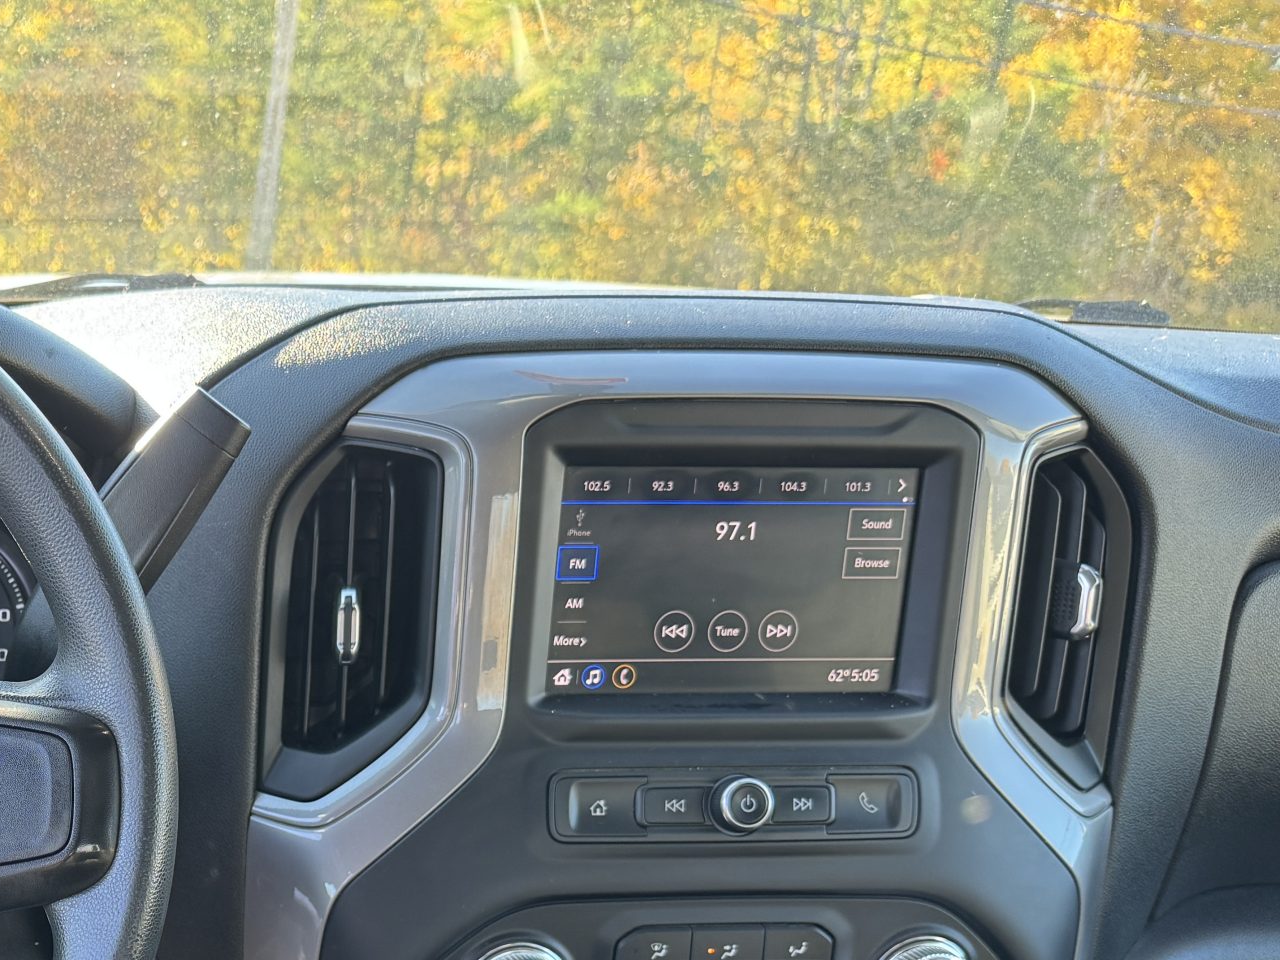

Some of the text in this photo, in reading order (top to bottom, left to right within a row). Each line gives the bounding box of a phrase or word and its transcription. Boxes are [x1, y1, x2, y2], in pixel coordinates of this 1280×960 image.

[583, 480, 611, 492] 102.5
[652, 480, 674, 492] 92.3
[717, 480, 740, 492] 96.3
[780, 481, 807, 493] 104.3
[844, 481, 872, 493] 101.3
[861, 518, 892, 530] Sound
[567, 528, 591, 538] iPhone
[715, 521, 757, 541] 97.1
[569, 558, 587, 570] FM
[854, 557, 890, 569] Browse
[565, 597, 584, 610] AM
[715, 626, 739, 637] Tune
